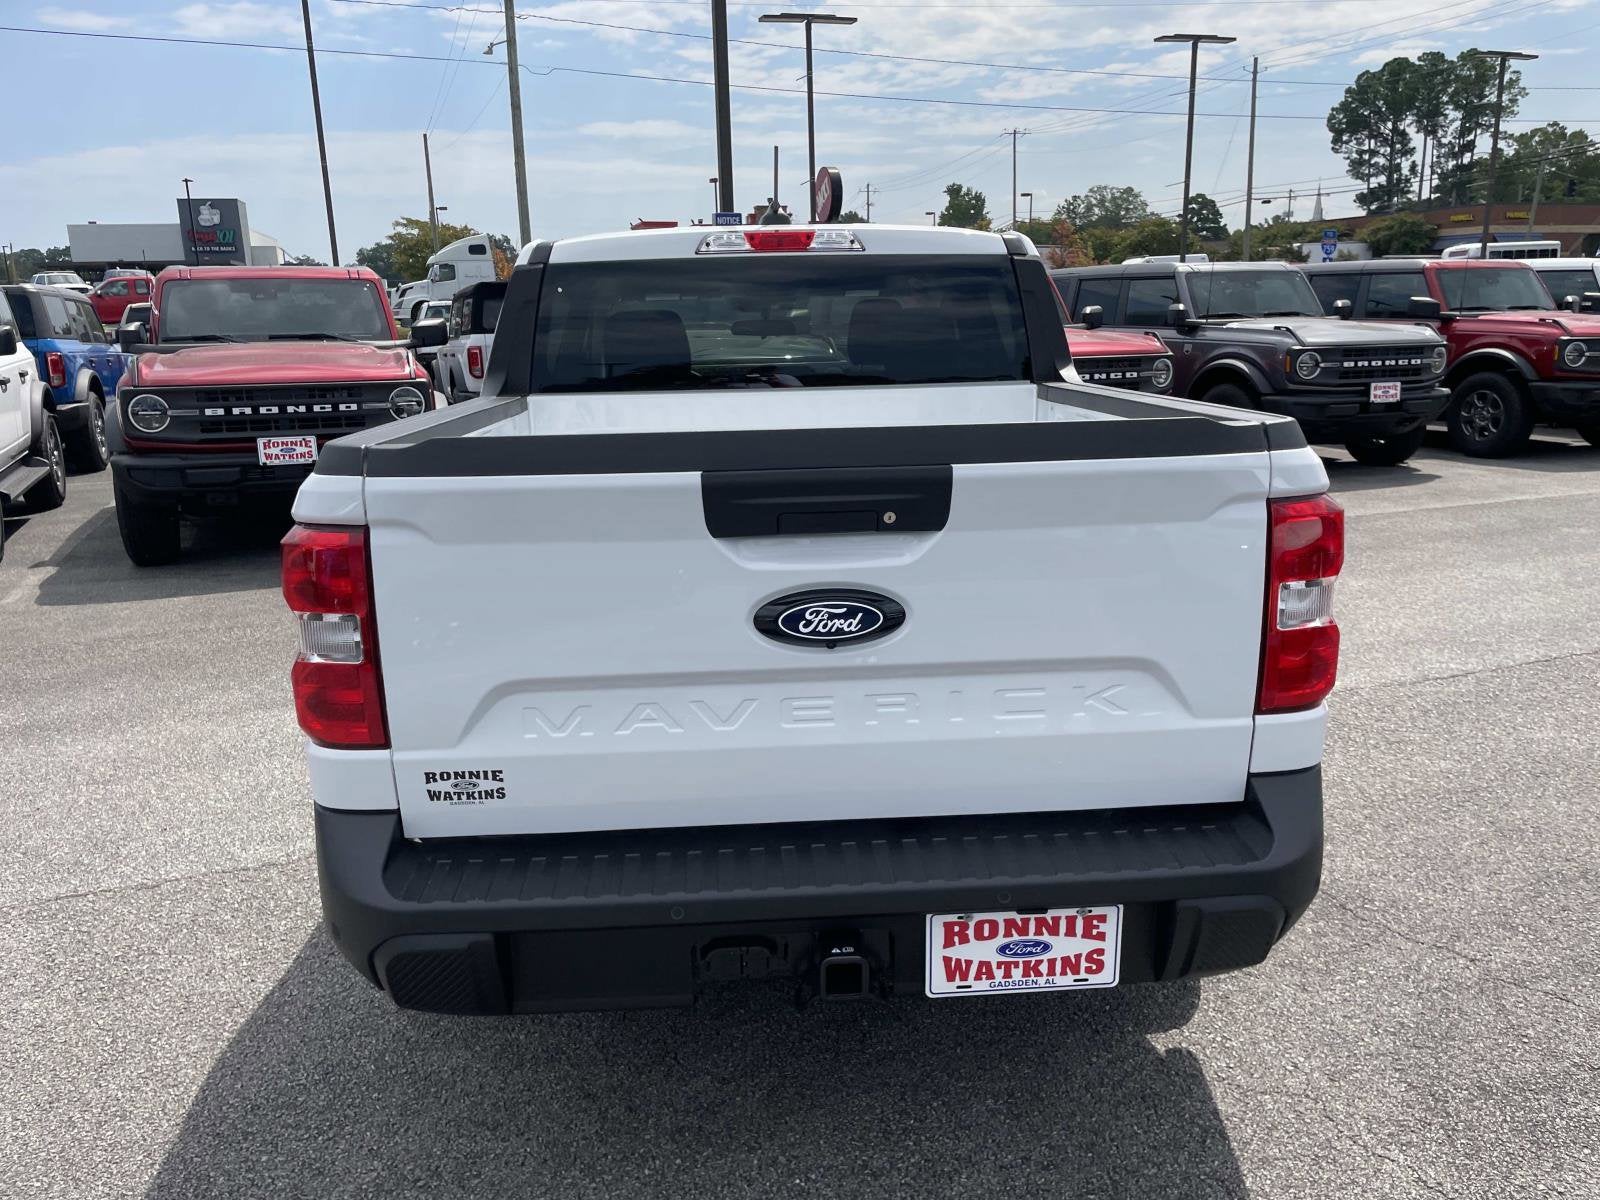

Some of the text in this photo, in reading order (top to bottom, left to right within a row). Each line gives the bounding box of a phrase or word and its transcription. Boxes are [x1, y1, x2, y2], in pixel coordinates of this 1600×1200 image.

[717, 216, 740, 225] NOTICE
[1343, 359, 1421, 367] BRONCO
[1079, 372, 1137, 380] ONCO
[205, 403, 358, 415] BRONCO
[263, 440, 312, 450] RONNIE
[264, 450, 313, 461] WATKINS
[799, 607, 861, 633] Ford
[522, 684, 1128, 738] MAVERICK
[424, 770, 504, 784] RONNIE
[427, 787, 506, 801] WATKINS
[943, 914, 1107, 949] RONNIE
[1005, 942, 1044, 954] Ford
[943, 948, 1105, 982] WATKINS
[989, 979, 1041, 989] GADSDEN,
